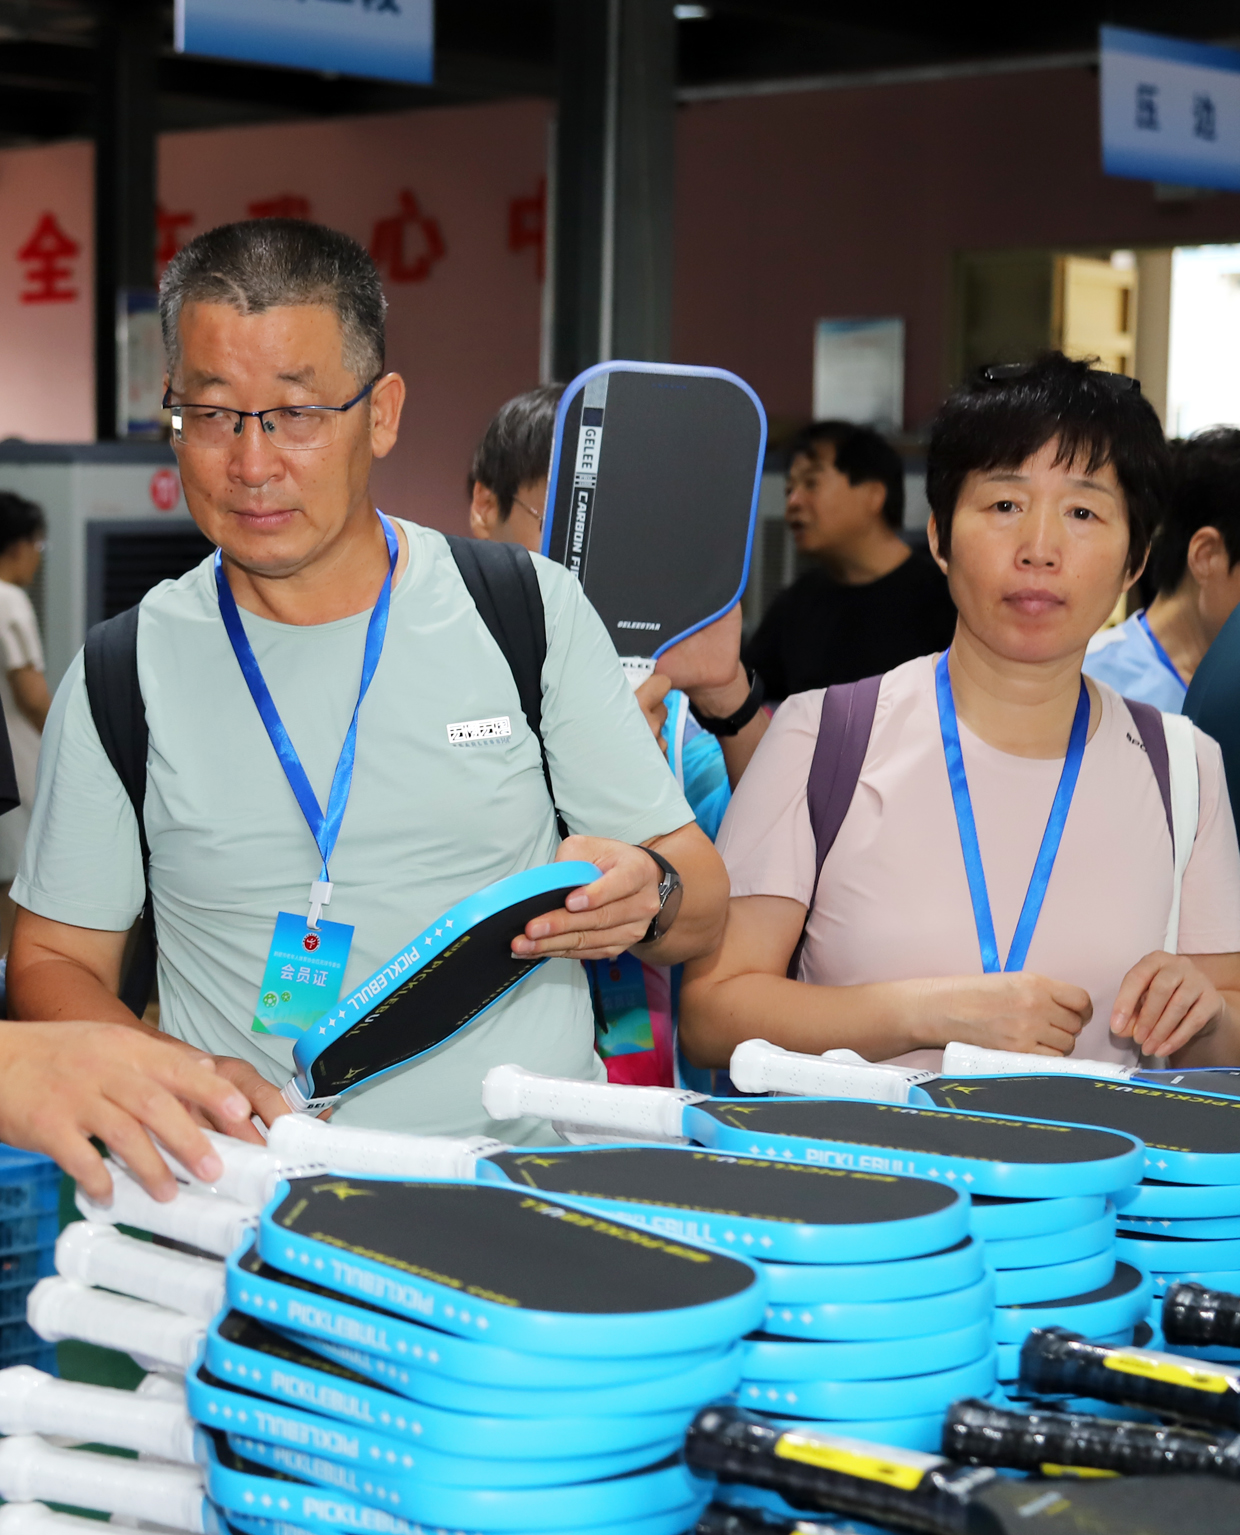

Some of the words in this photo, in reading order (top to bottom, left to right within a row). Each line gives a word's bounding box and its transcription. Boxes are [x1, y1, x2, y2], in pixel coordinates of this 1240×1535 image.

[581, 428, 597, 470] GELEE
[572, 491, 589, 553] CARBON
[621, 661, 652, 670] ELEE
[280, 963, 339, 987] 会员证
[345, 960, 444, 1038] PICKLEBULL
[346, 946, 421, 1010] PICKLEBULL
[1094, 1082, 1229, 1107] PICKLEBULL
[287, 1299, 393, 1352] PICKLEBULL
[271, 1370, 376, 1423] PICKLEBULL
